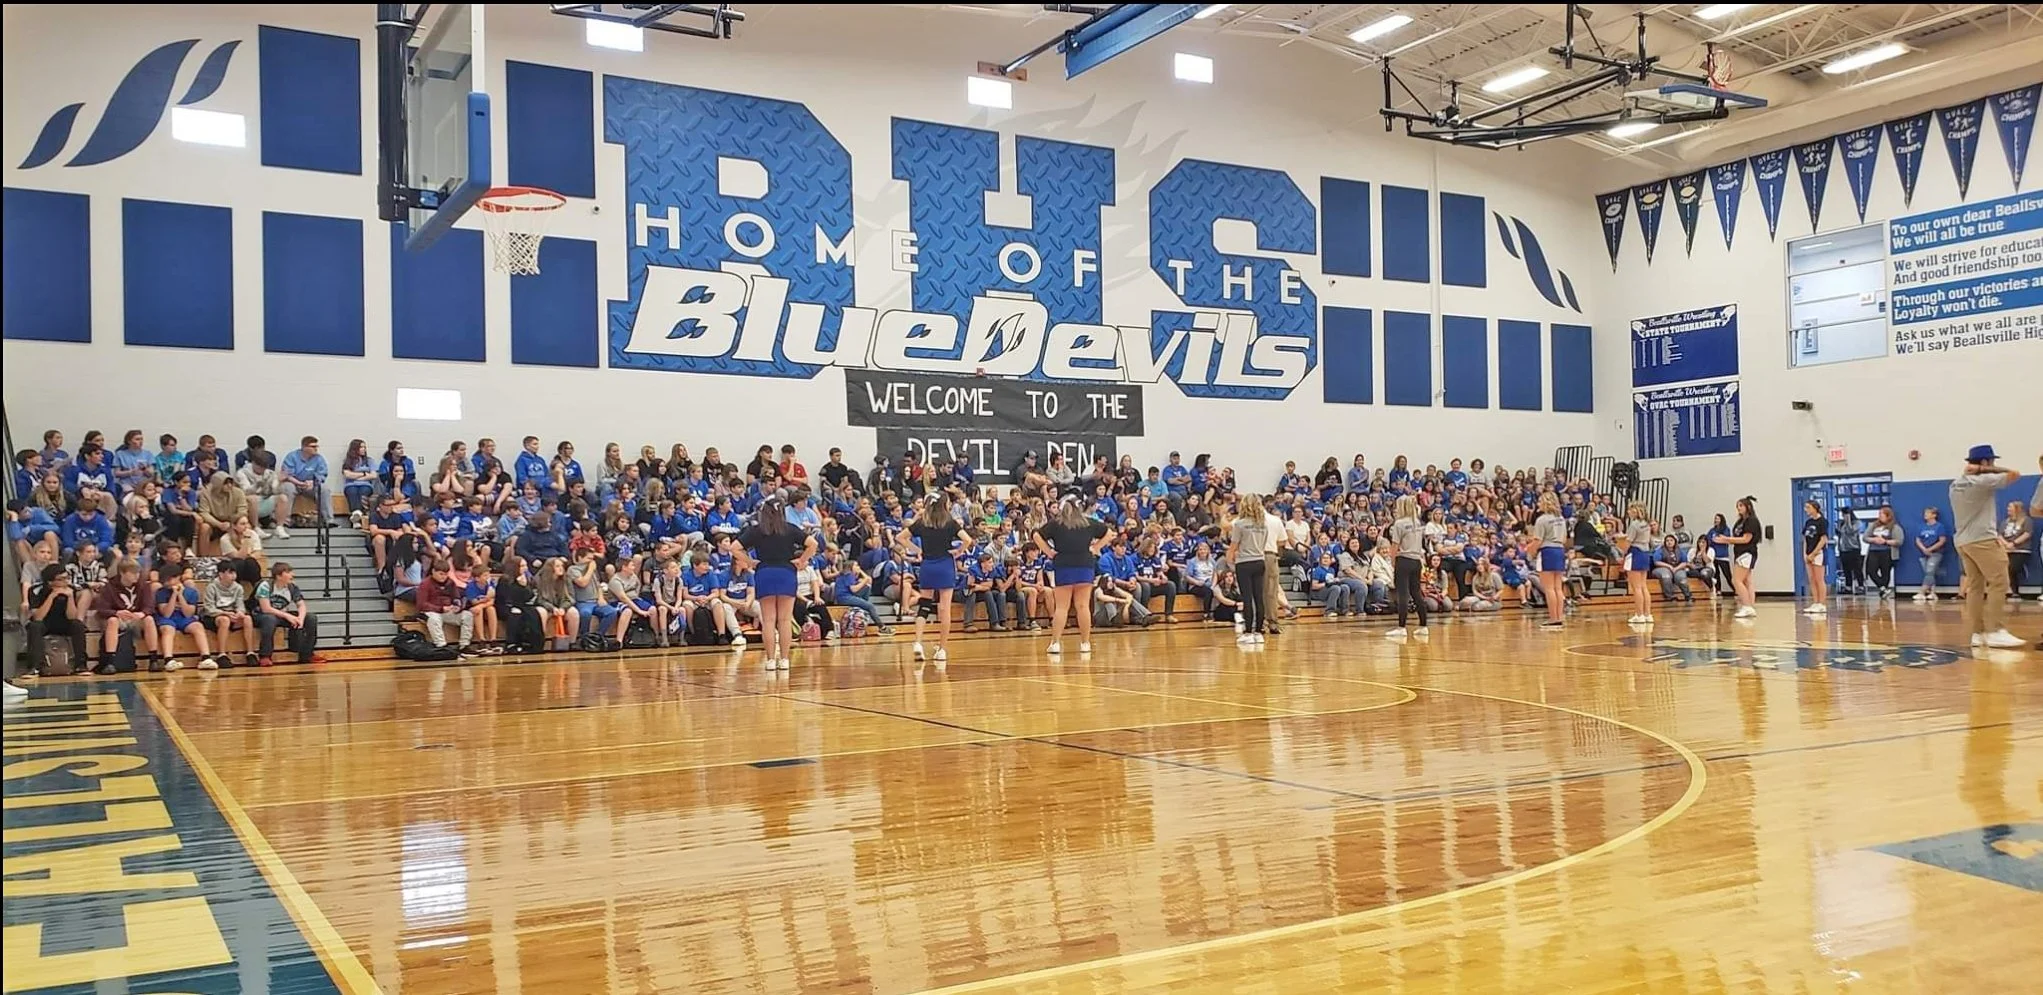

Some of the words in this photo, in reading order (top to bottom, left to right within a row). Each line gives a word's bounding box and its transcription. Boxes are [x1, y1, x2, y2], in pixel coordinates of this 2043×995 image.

[1999, 91, 2022, 104] OVAC
[1945, 107, 1967, 120] OVAC
[2001, 109, 2032, 121] CHAMPS
[1894, 120, 1914, 132] OVAC
[1948, 127, 1977, 139] CHAMPS
[1846, 130, 1866, 143] OVAC
[1758, 152, 1776, 164] OVAC
[1896, 142, 1922, 154] CHAMPS
[1717, 164, 1738, 174] OVAC
[1892, 224, 1907, 236] To
[1910, 221, 1930, 234] our
[1933, 215, 1960, 229] own
[1963, 209, 1992, 223] dear
[1892, 236, 1911, 249] We
[1914, 231, 1937, 246] will
[1940, 227, 1957, 240] all
[1960, 224, 1975, 237] be
[1978, 220, 2004, 233] true
[634, 202, 919, 273] HOME
[998, 241, 1098, 289] OF
[1166, 259, 1302, 305] THE
[1893, 259, 1912, 272] We
[1916, 254, 1938, 268] will
[1942, 250, 1977, 265] strive
[1981, 245, 1997, 258] for
[1893, 271, 1917, 285] And
[1920, 267, 1950, 283] good
[1953, 256, 2019, 276] friendship
[1893, 289, 1946, 308] Through
[1948, 287, 1970, 300] our
[1973, 278, 2028, 295] victories
[1894, 303, 1939, 321] Loyalty
[1941, 298, 1977, 313] won't
[1978, 296, 2003, 309] die.
[1895, 330, 1917, 342] Ask
[1920, 327, 1935, 339] us
[1938, 323, 1969, 336] what
[1973, 320, 1992, 332] we
[1995, 316, 2012, 329] all
[2015, 315, 2037, 326] are
[1895, 341, 1925, 355] We'll
[1928, 337, 1949, 352] say
[1953, 329, 2020, 348] Beallsville
[865, 381, 994, 416] WELCOME
[1025, 390, 1059, 419] TO
[1086, 393, 1128, 419] THE
[1650, 400, 1669, 410] OVAC
[1669, 394, 1721, 408] TOURNAMENT
